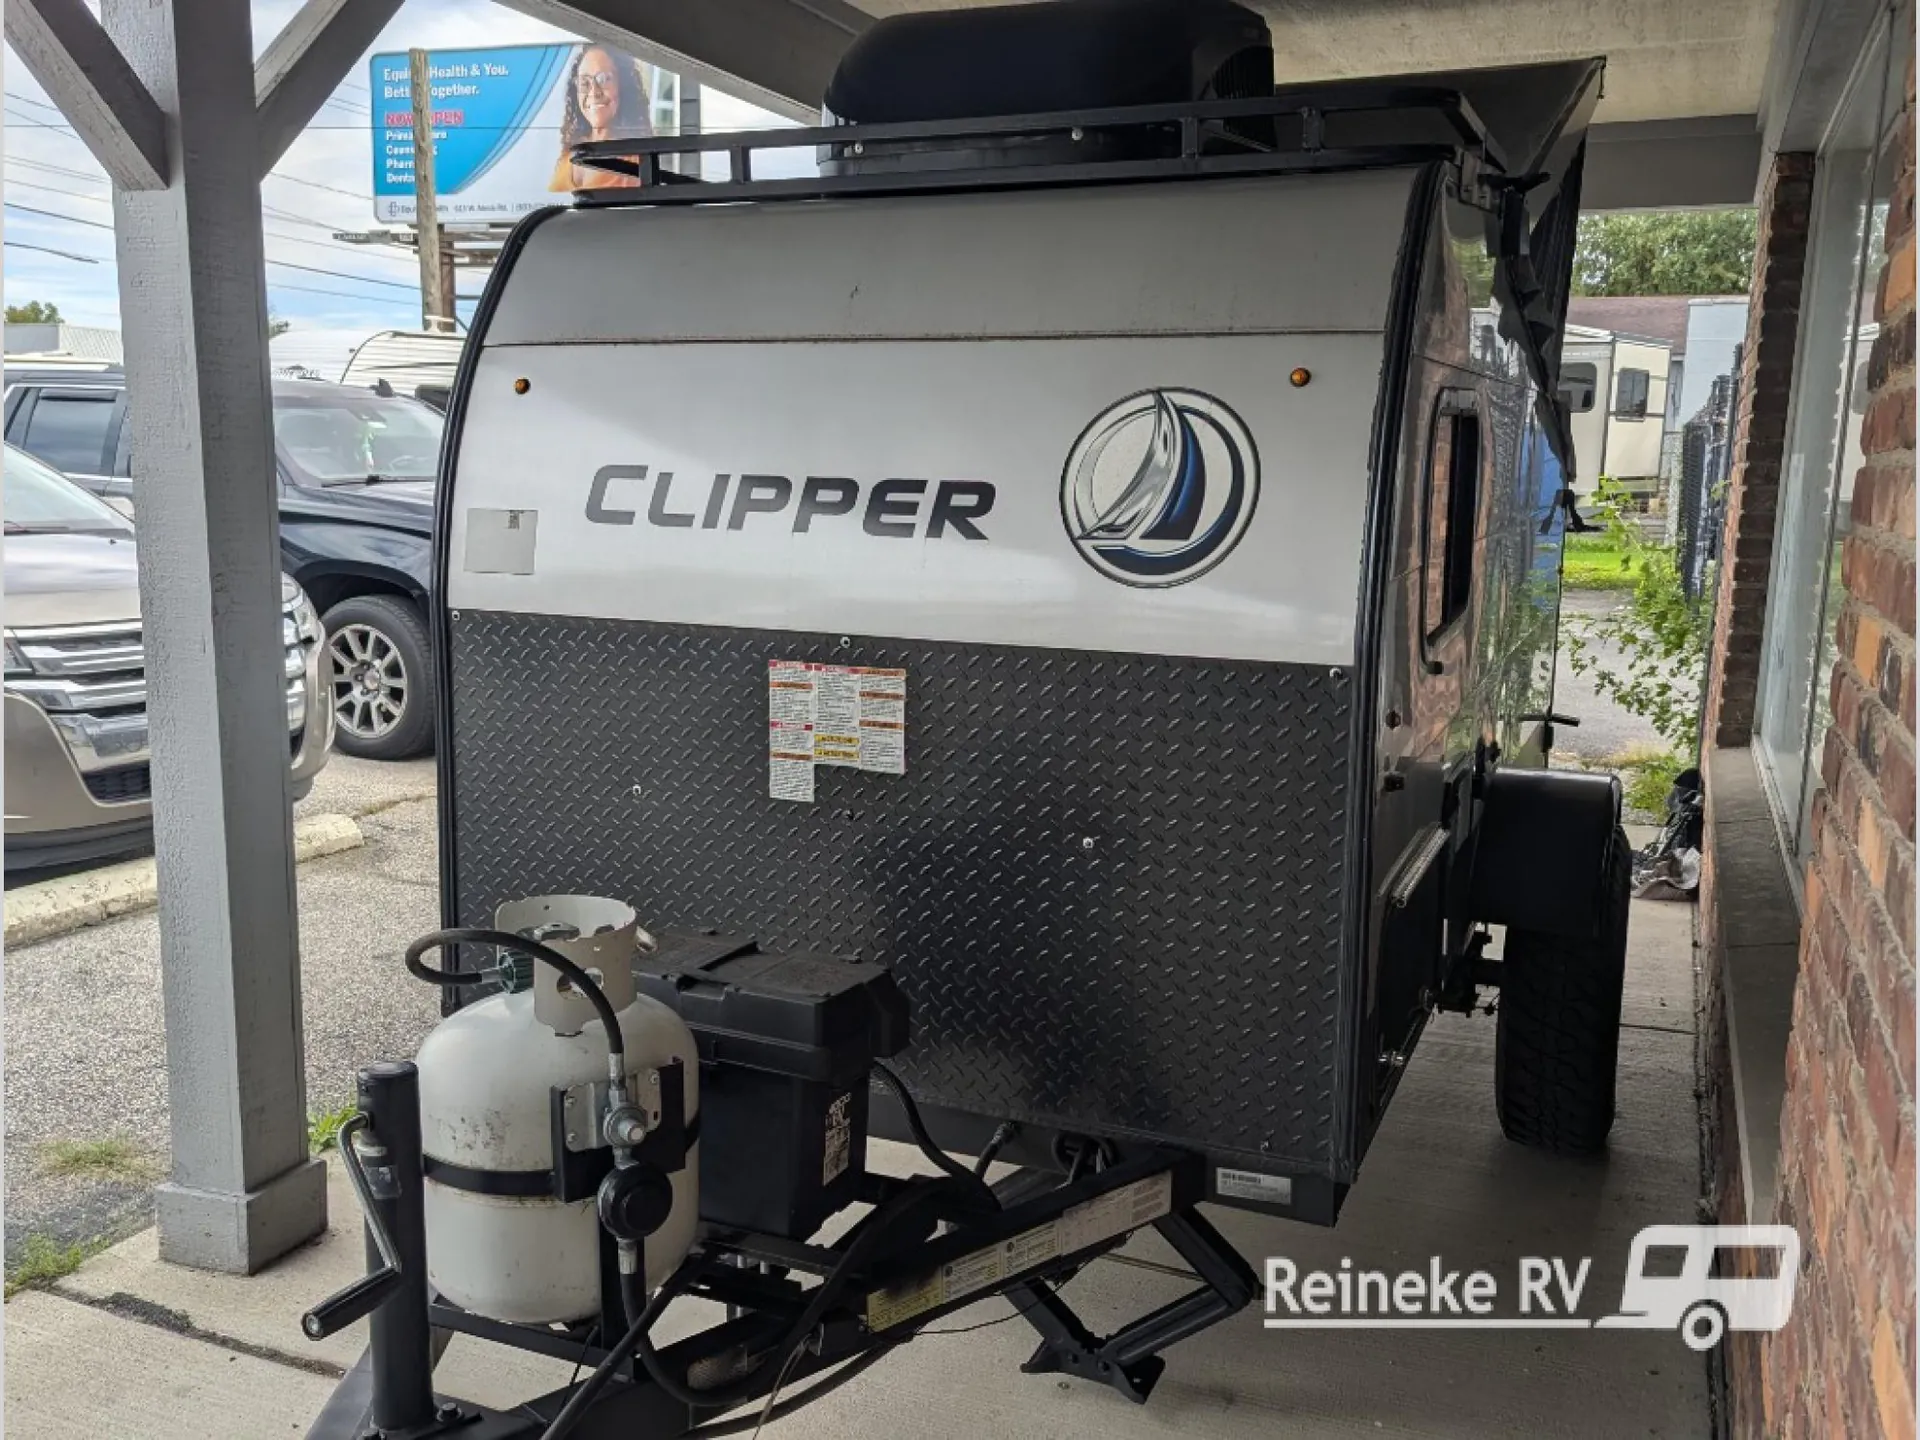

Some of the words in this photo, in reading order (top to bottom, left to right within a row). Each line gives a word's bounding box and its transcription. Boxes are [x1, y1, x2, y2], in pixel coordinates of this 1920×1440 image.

[430, 64, 468, 78] Health
[470, 61, 481, 76] &
[484, 62, 509, 76] You.
[384, 86, 411, 98] Bett
[430, 84, 480, 100] ogether.
[584, 464, 997, 541] CLIPPER
